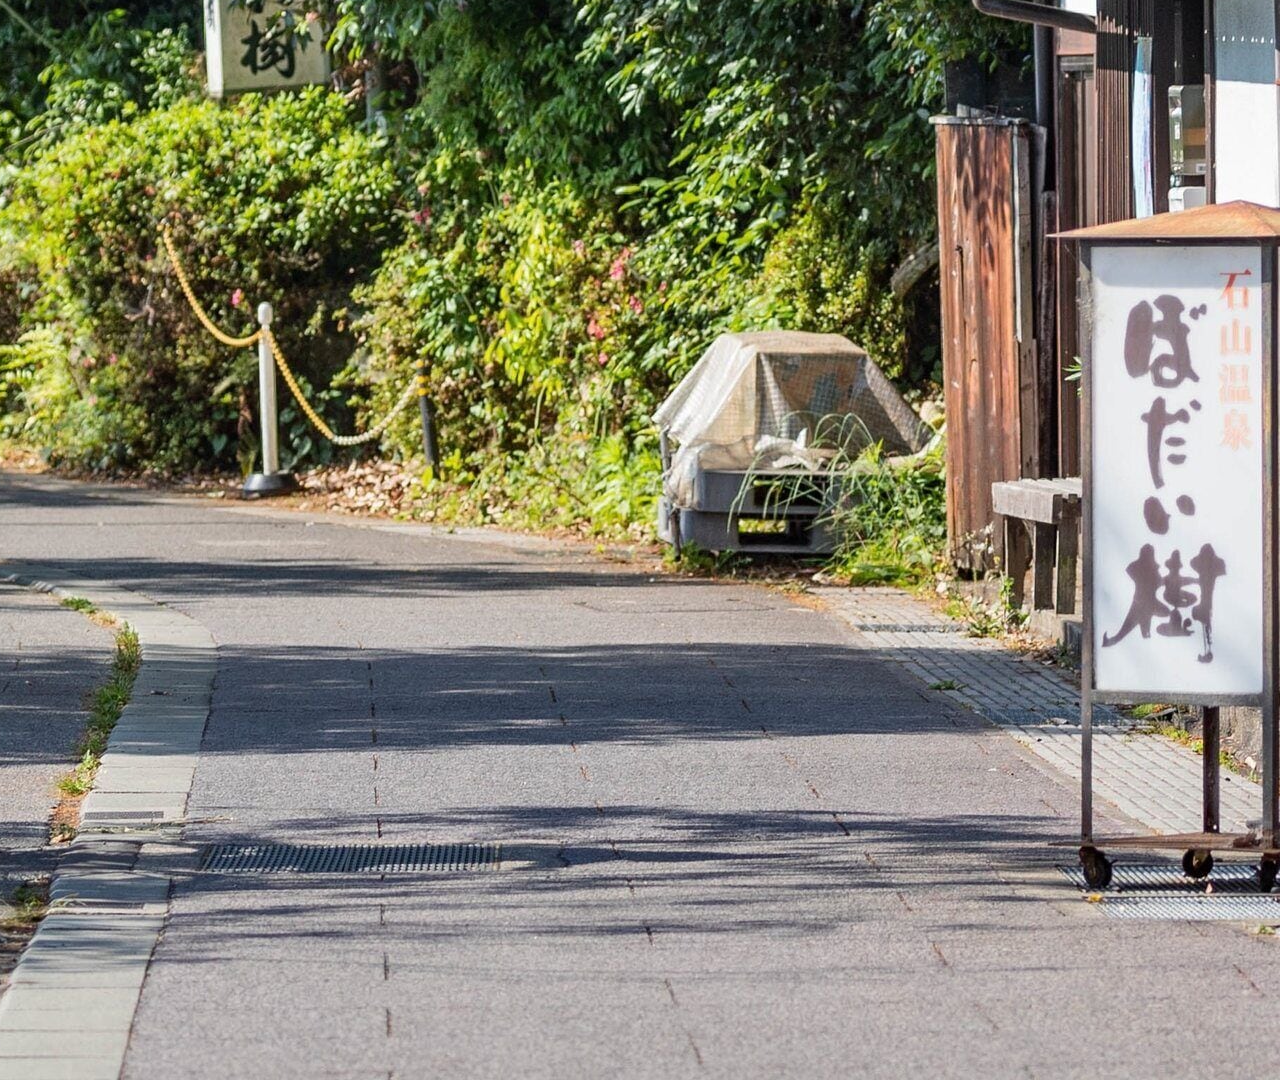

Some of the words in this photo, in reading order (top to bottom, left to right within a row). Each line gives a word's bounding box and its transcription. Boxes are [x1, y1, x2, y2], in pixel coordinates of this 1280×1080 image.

[1102, 294, 1228, 664] ぼだい樹
[1219, 269, 1253, 451] 石山温泉
